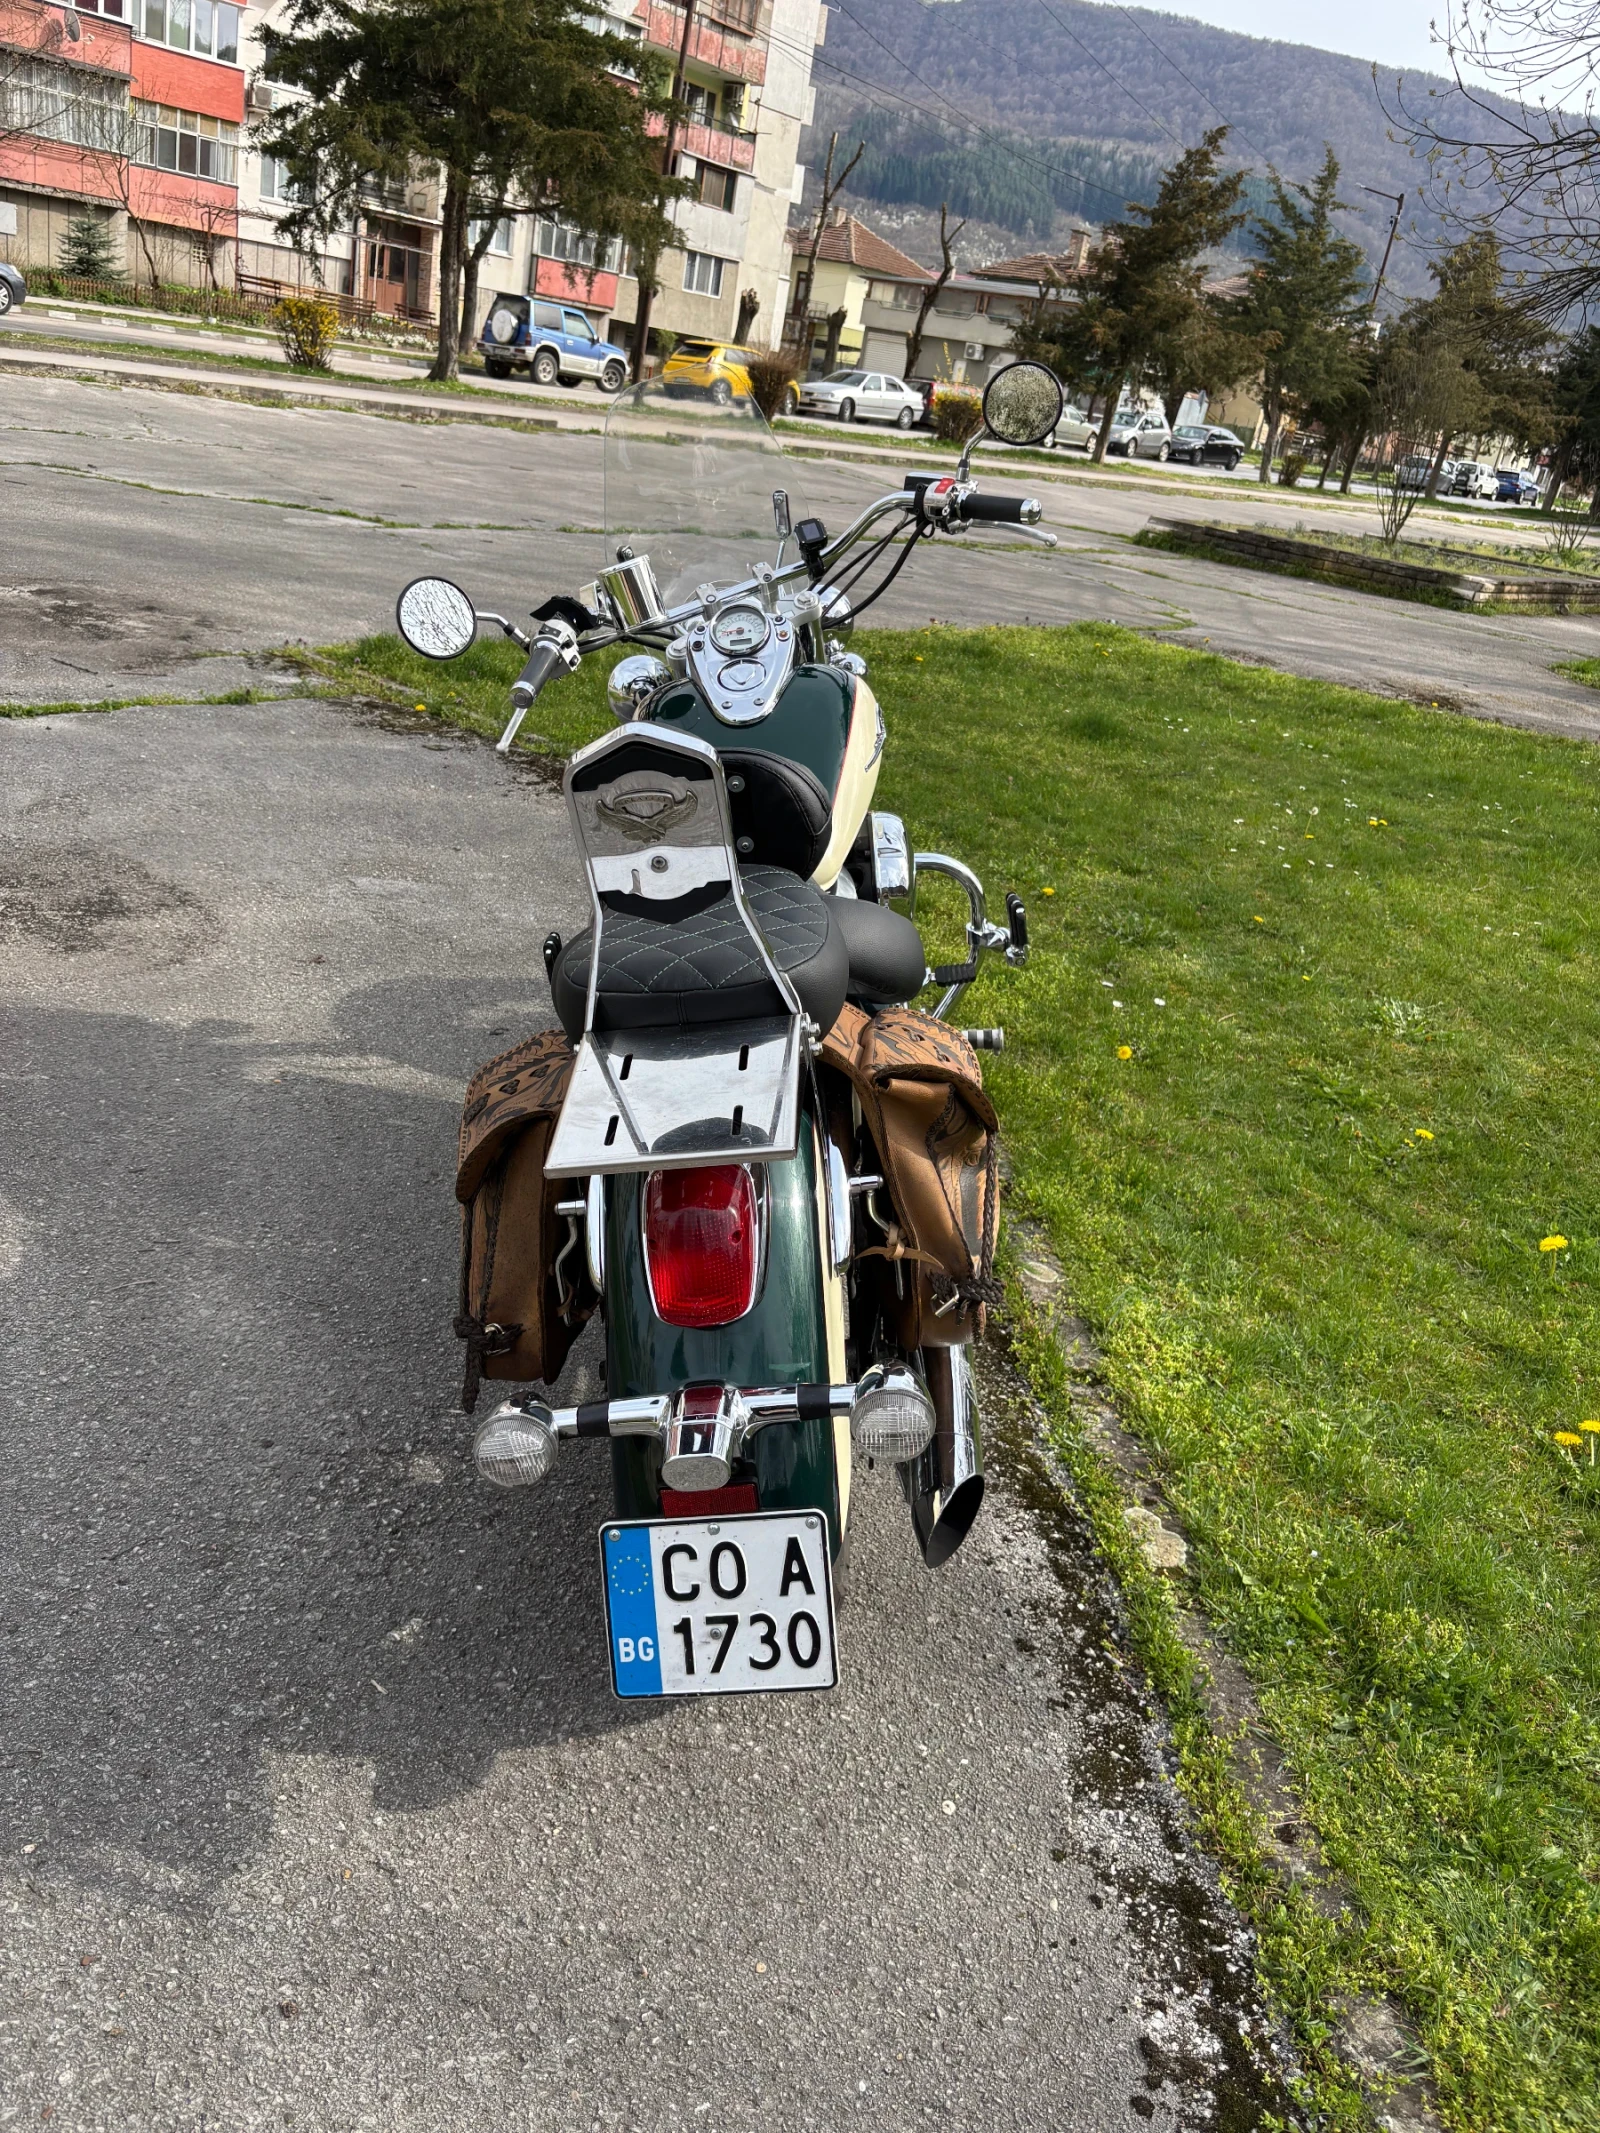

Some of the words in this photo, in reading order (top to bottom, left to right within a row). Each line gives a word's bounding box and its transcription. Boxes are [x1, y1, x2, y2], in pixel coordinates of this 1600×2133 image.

[662, 1541, 747, 1600] CO
[780, 1537, 815, 1596] A
[618, 1637, 654, 1662] BG
[673, 1611, 821, 1674] 1730
